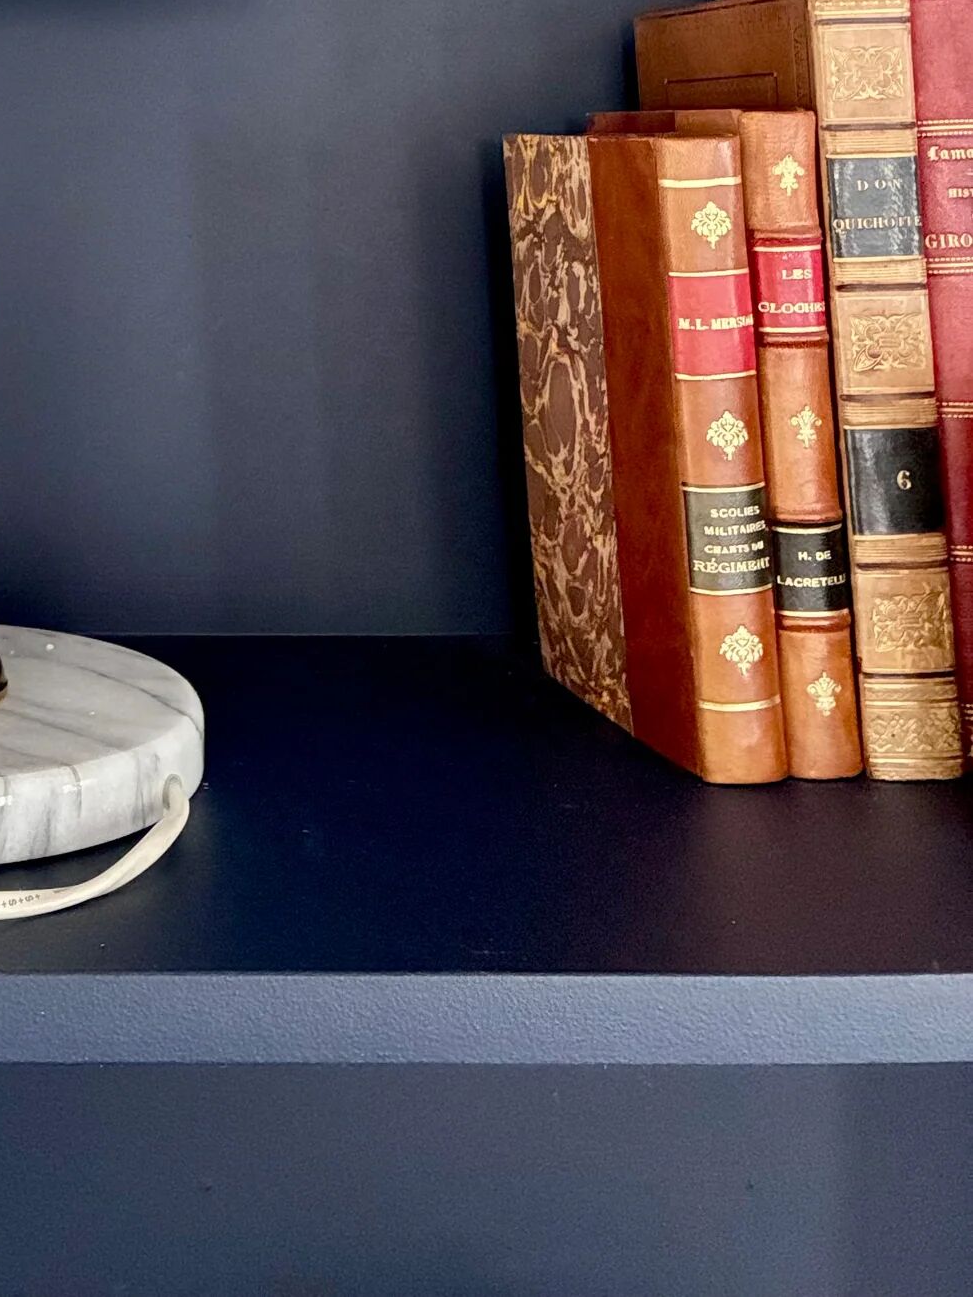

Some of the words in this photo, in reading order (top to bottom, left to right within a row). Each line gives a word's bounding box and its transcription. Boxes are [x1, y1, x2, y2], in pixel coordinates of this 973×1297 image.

[782, 268, 812, 280] LES
[896, 470, 912, 490] 6
[710, 505, 761, 518] SCOLIES
[703, 544, 749, 554] CHANTS
[751, 540, 764, 551] DU
[798, 552, 813, 561] H.
[815, 551, 831, 561] DE
[692, 557, 770, 574] RÉGIMENT
